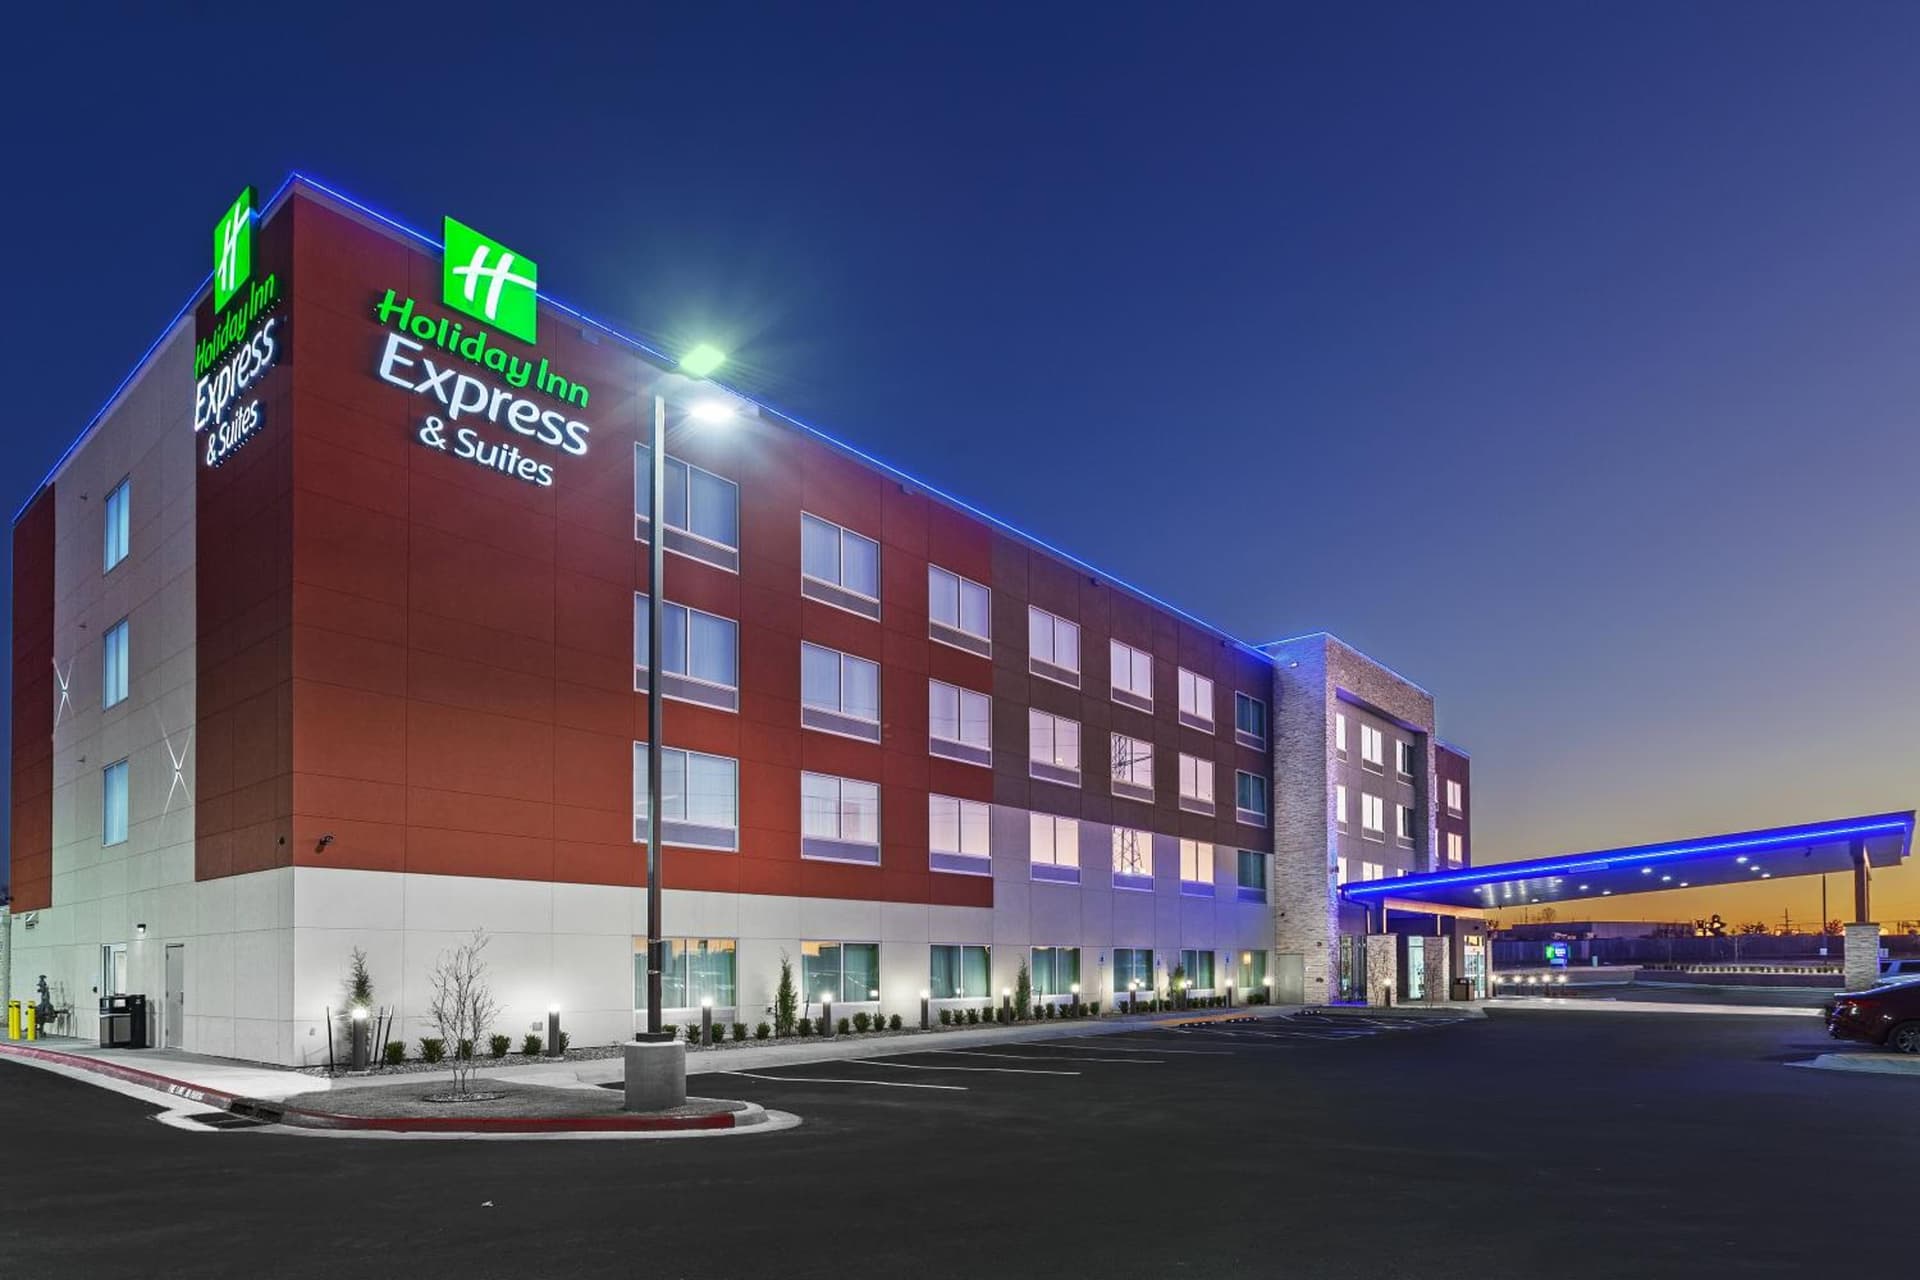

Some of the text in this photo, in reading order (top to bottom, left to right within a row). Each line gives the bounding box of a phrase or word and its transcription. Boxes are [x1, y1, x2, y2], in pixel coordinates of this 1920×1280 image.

[194, 274, 275, 380] Holiday Inn
[194, 318, 275, 432] Express
[377, 289, 590, 409] Holiday Inn
[206, 399, 259, 466] & Suites
[379, 332, 590, 456] Express
[419, 416, 554, 486] & Suites
